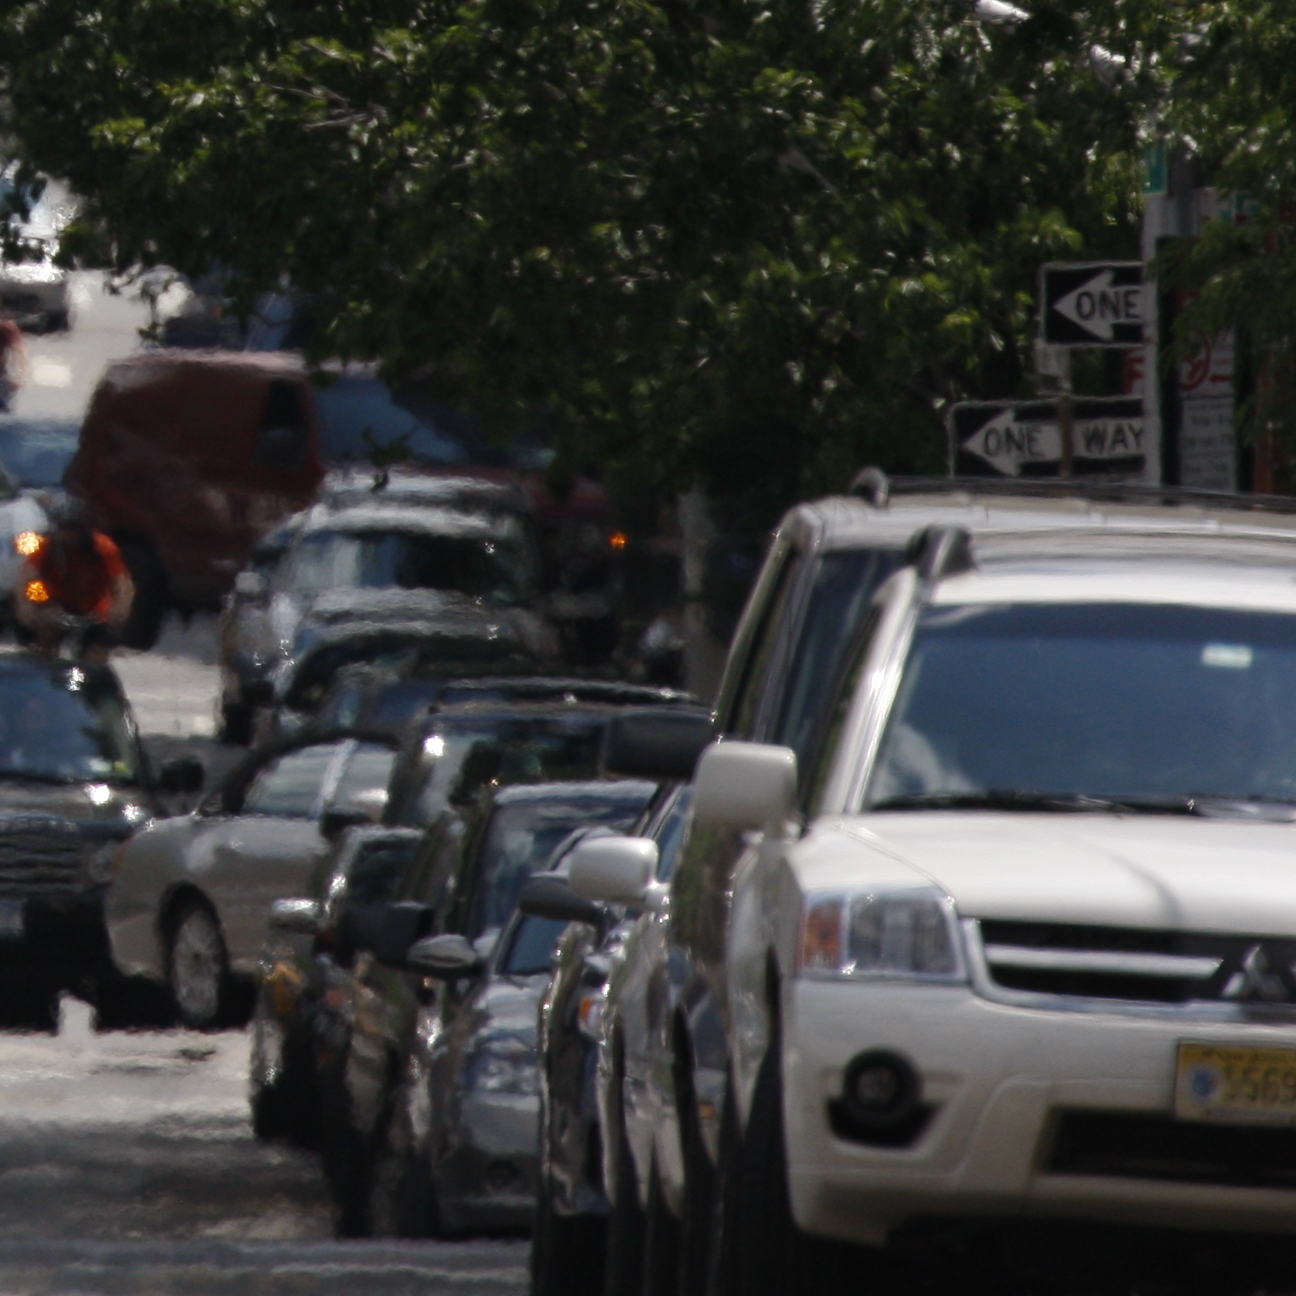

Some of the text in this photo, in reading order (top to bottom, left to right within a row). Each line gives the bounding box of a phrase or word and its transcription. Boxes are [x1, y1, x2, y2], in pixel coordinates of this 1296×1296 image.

[1075, 290, 1141, 321] ONE
[983, 423, 1145, 457] ONE WAY
